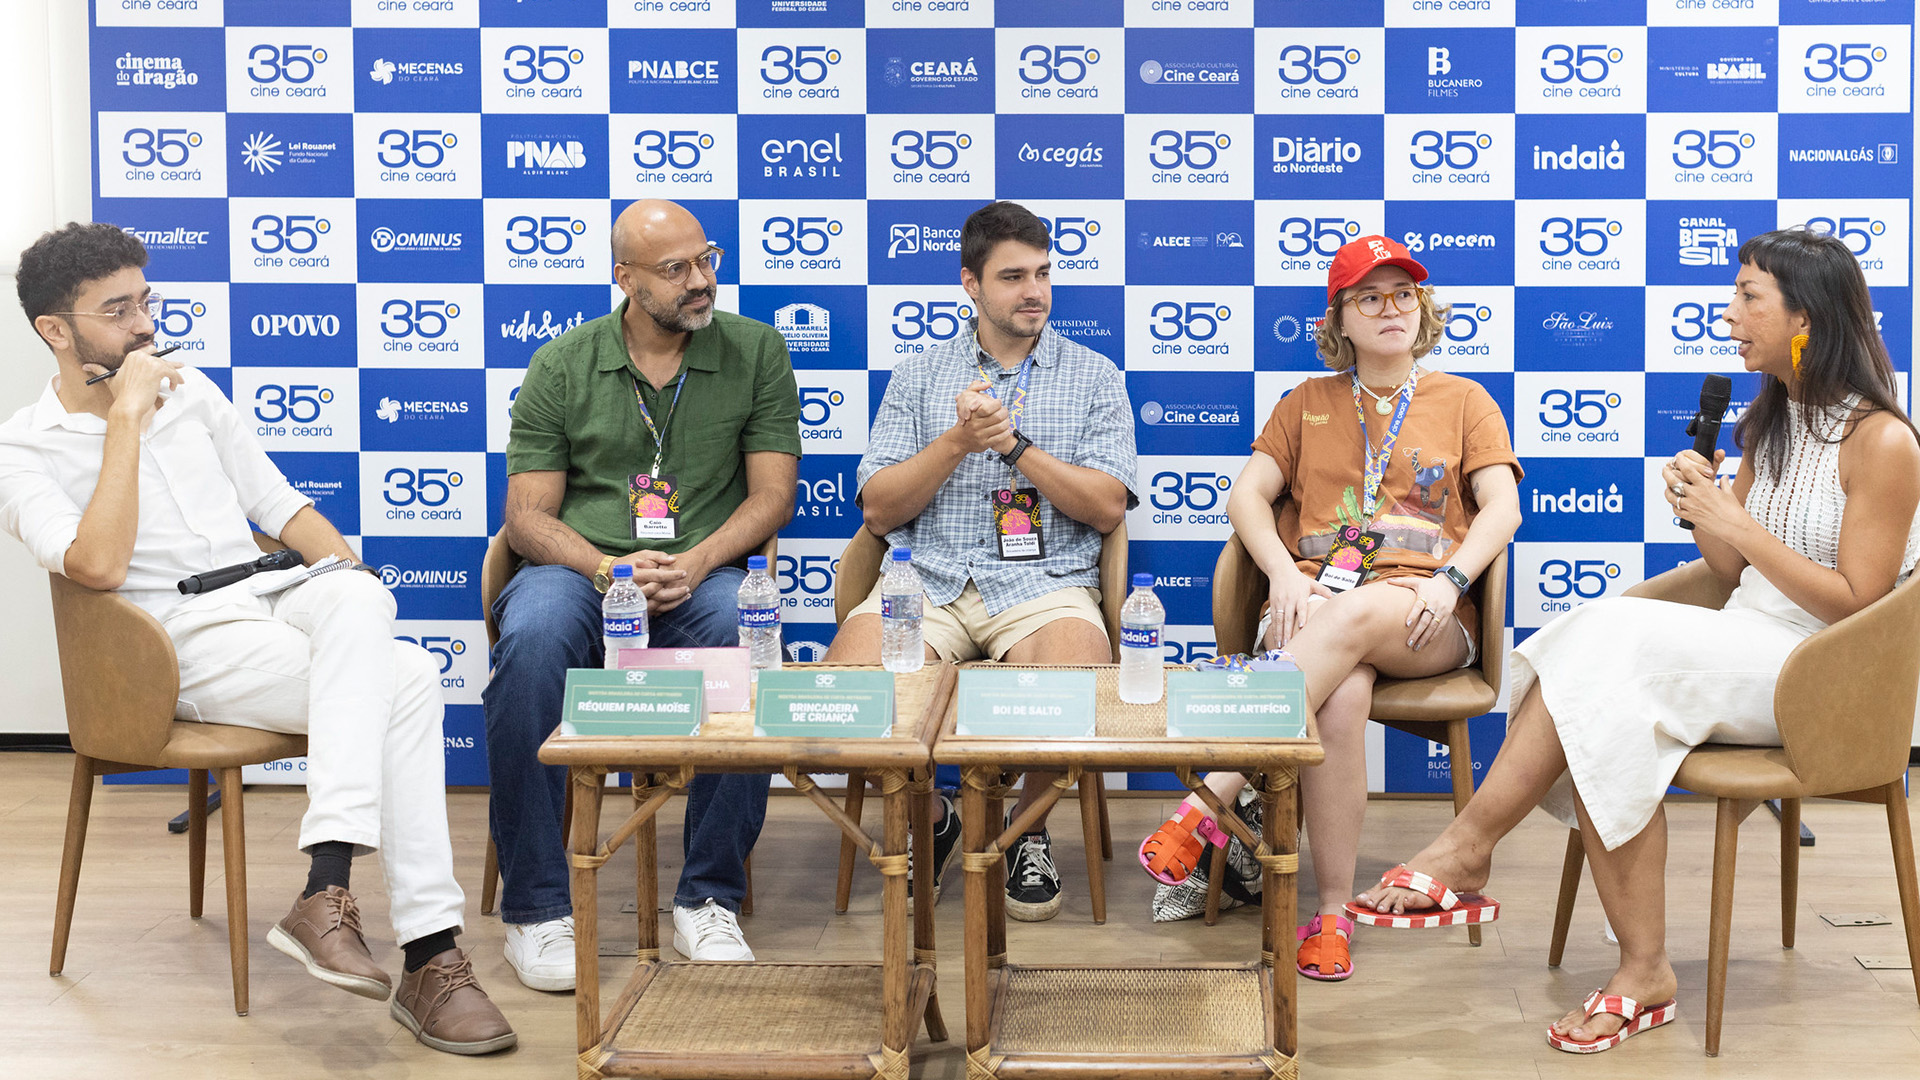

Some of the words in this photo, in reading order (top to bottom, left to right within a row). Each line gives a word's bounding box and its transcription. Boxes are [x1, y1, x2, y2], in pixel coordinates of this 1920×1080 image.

[634, 0, 663, 11] cine
[115, 52, 182, 69] cinema
[910, 57, 977, 76] CEARÁ
[399, 63, 463, 74] MECENAS
[629, 61, 718, 78] PNABCE
[1707, 63, 1766, 79] BRASIL
[116, 70, 130, 81] do
[133, 69, 198, 89] dragão
[1163, 70, 1195, 82] Cine
[1199, 70, 1239, 82] Ceará
[1428, 79, 1482, 87] BUCANERO
[251, 86, 279, 98] cine
[286, 84, 326, 98] ceará
[763, 87, 792, 99] cine
[799, 86, 839, 99] ceará
[1281, 87, 1311, 99] cine
[1317, 86, 1358, 99] ceará
[507, 141, 586, 168] PNAB
[762, 133, 842, 163] enel
[1273, 137, 1361, 162] Diário
[1534, 139, 1624, 170] indaiá
[1790, 147, 1874, 162] NACIONALGÁS
[1042, 143, 1103, 167] cegás
[764, 166, 840, 177] BRASIL
[1273, 163, 1288, 173] do
[1290, 163, 1344, 173] Nordeste
[381, 171, 409, 183] cine
[416, 170, 456, 183] ceará
[894, 172, 923, 184] cine
[929, 170, 970, 184] ceará
[1675, 171, 1704, 183] cine
[1711, 170, 1752, 183] ceará
[1679, 217, 1726, 227] CANAL
[122, 228, 209, 245] Esmaltec
[922, 226, 961, 239] Banco
[1679, 229, 1738, 247] BRA
[922, 239, 961, 251] Norde
[1153, 236, 1191, 246] ALECE
[1430, 232, 1496, 250] pecém
[1679, 247, 1729, 265] SIL
[765, 258, 794, 270] cine
[800, 256, 840, 270] ceará
[1542, 259, 1572, 271] cine
[1579, 258, 1620, 271] ceará
[1152, 343, 1182, 355] cine
[1188, 342, 1229, 355] ceará
[404, 401, 468, 413] MECENAS
[1165, 403, 1204, 411] ASSOCIAÇÃO
[1164, 411, 1195, 423] Cine
[1200, 410, 1240, 423] Ceará
[257, 427, 286, 439] cine
[292, 426, 332, 439] ceará
[1541, 431, 1571, 443] cine
[1577, 430, 1619, 443] ceará
[797, 473, 846, 503] nel
[1533, 483, 1623, 513] indaiá
[386, 510, 415, 522] cine
[421, 508, 461, 522] ceará
[797, 506, 843, 516] ASIL
[1154, 577, 1190, 586] ALECE
[578, 701, 624, 712] RÉQUIEM
[626, 704, 654, 712] PARA
[789, 703, 859, 713] BRINCADEIRA
[993, 706, 1011, 715] BOI
[1013, 706, 1027, 715] DE
[1029, 706, 1062, 716] SALTO
[1186, 704, 1221, 714] FOGOS
[1223, 704, 1237, 713] DE
[1239, 702, 1291, 714] ARTIFÍCIO
[792, 713, 806, 722] DE
[808, 713, 855, 724] CRIANÇA
